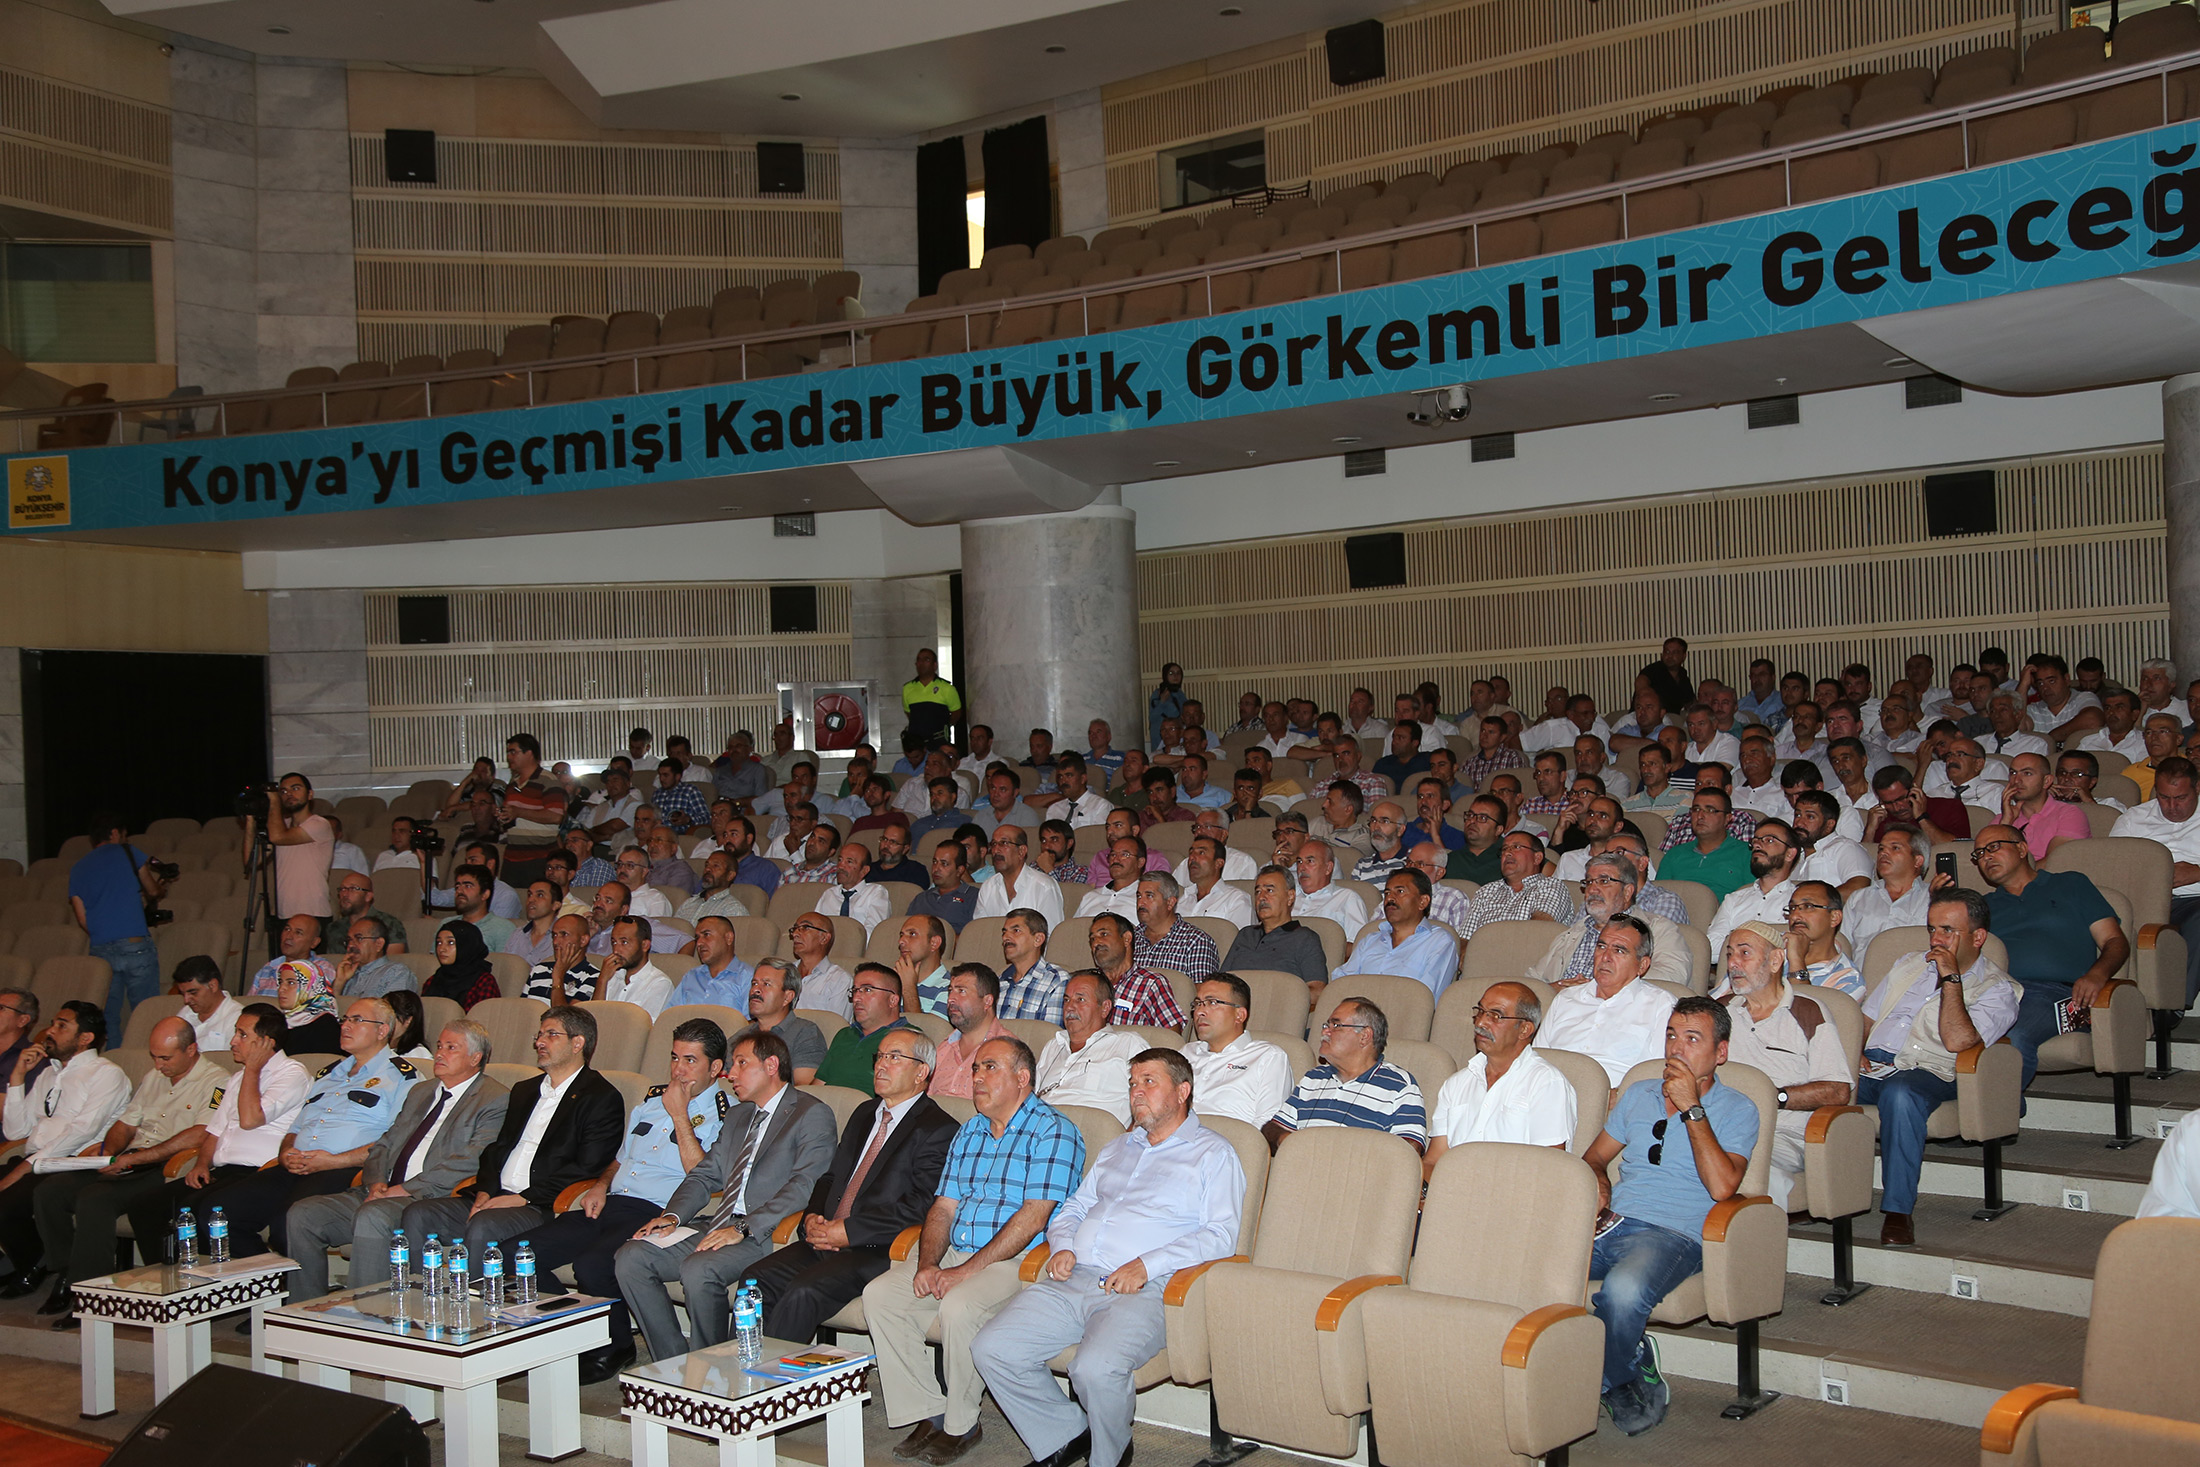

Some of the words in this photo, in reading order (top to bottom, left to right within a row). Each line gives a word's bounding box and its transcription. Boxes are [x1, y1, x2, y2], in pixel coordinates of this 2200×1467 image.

[163, 441, 420, 511] Konya'yı
[440, 406, 683, 485] Geçmişi
[704, 389, 900, 459] Kadar
[921, 350, 1163, 437] Büyük,
[1186, 275, 1561, 399] Görkemli
[1592, 254, 1732, 338] Bir
